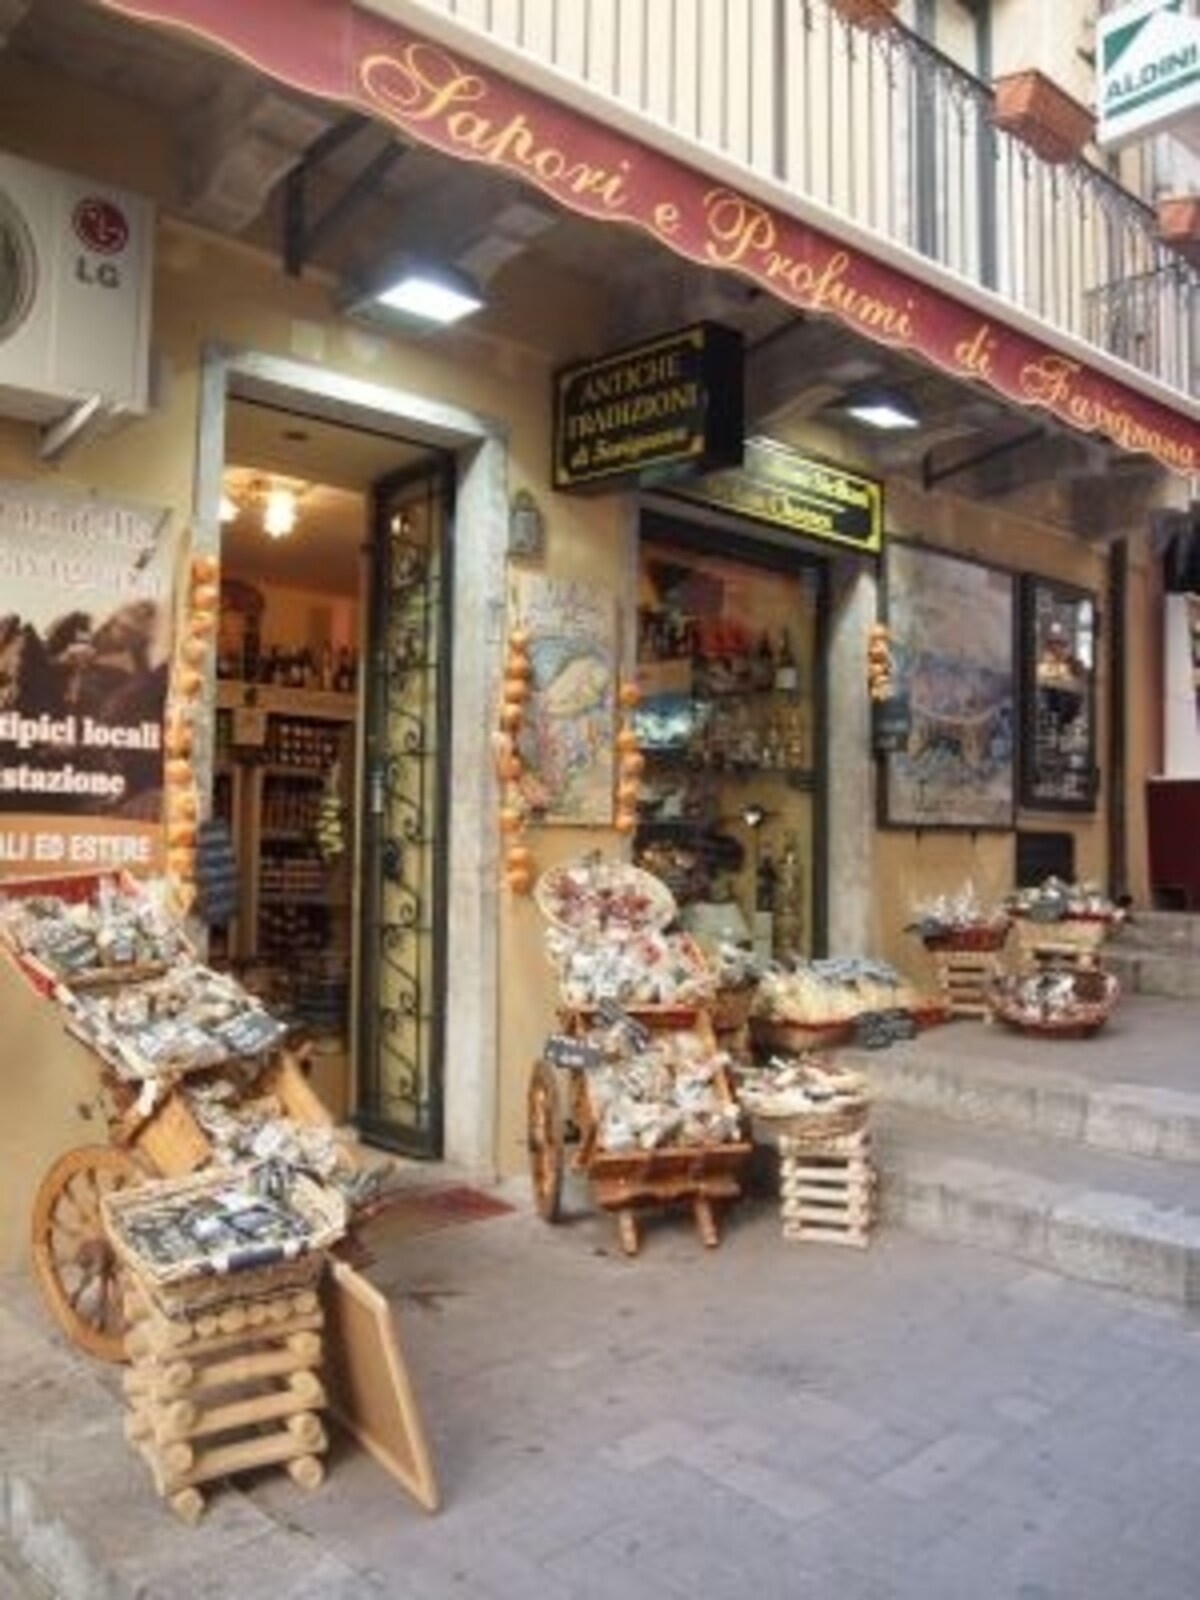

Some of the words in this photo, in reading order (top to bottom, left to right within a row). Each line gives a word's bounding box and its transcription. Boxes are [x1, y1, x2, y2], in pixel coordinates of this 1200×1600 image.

[360, 44, 628, 205] Sapori
[655, 203, 682, 234] e
[703, 186, 912, 336] Profumi
[954, 324, 992, 381] di
[76, 256, 120, 289] LG
[580, 354, 684, 404] ANTICHE
[82, 717, 161, 750] locali
